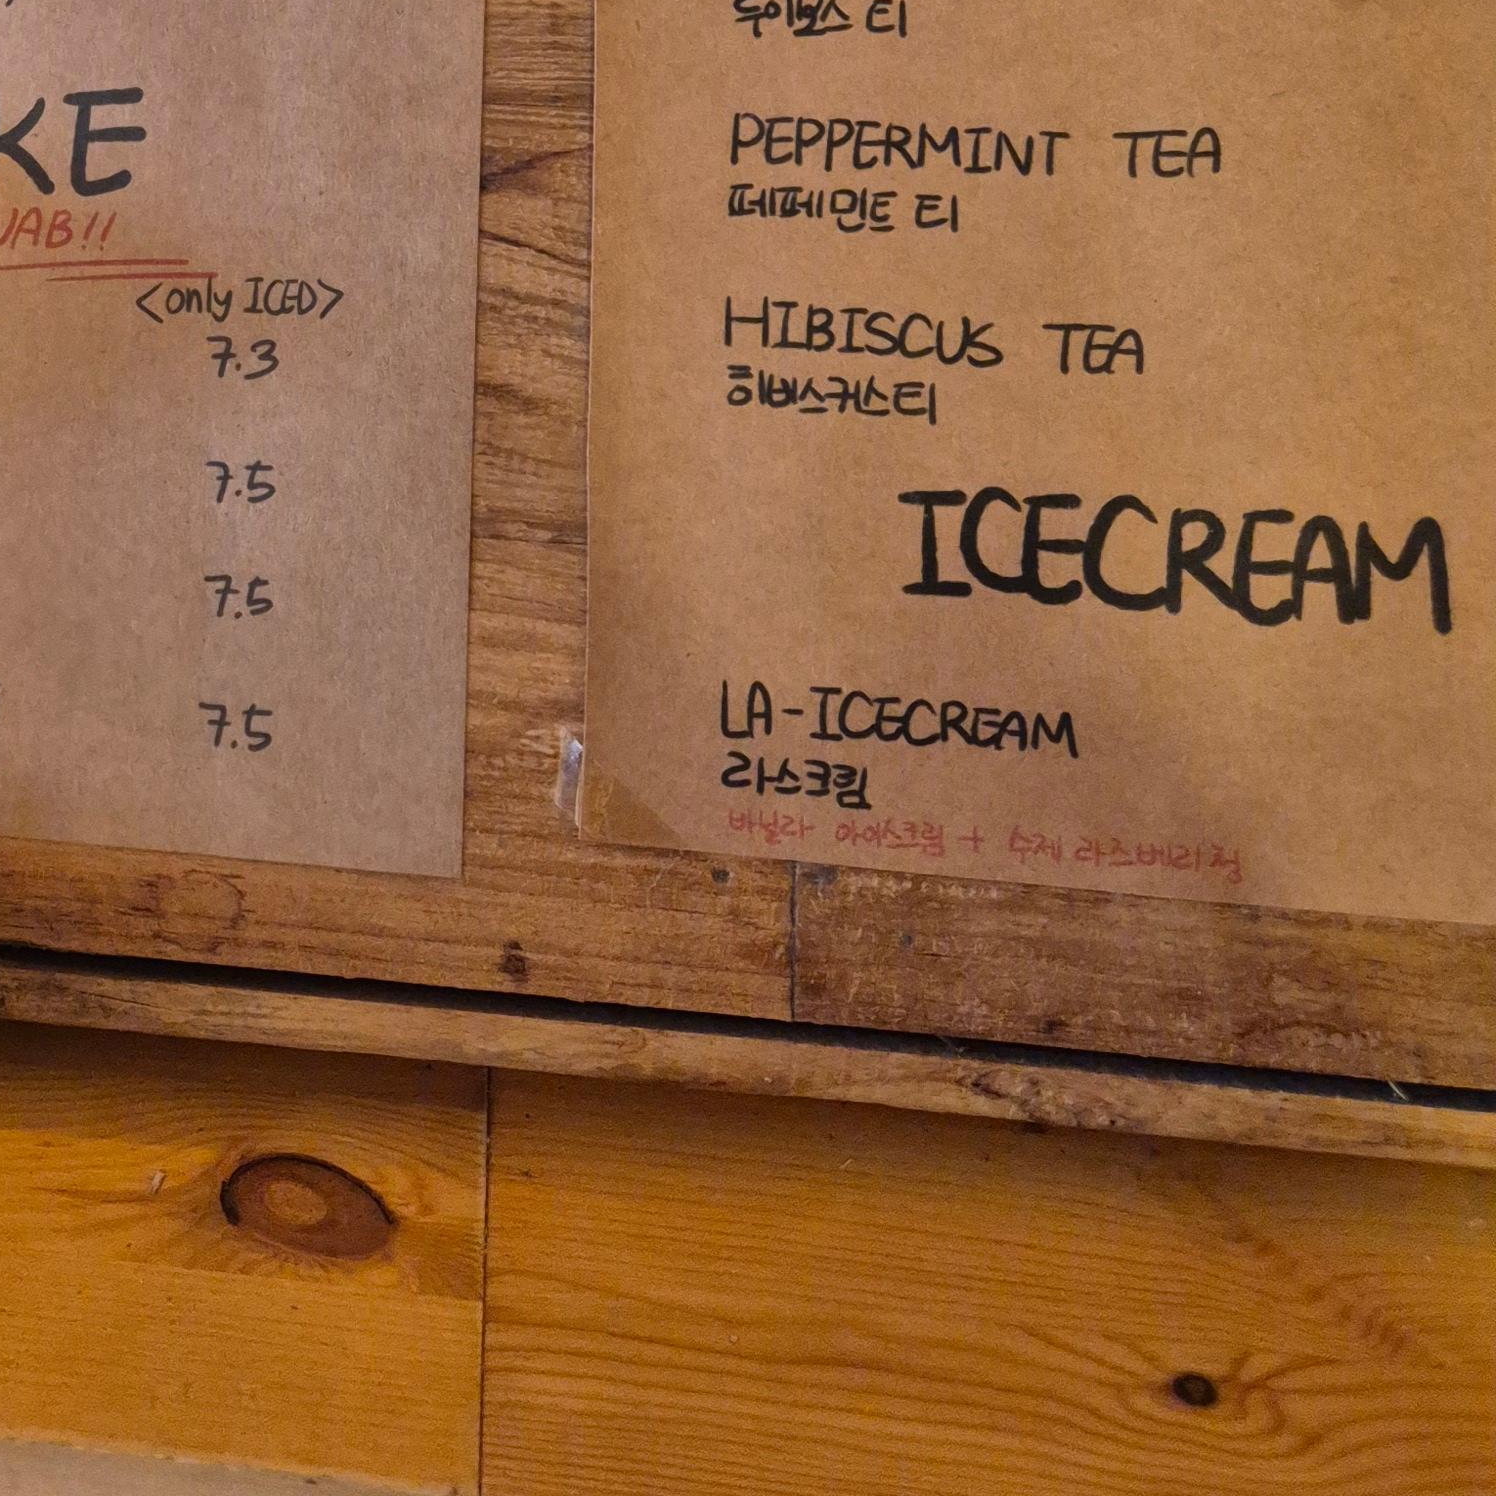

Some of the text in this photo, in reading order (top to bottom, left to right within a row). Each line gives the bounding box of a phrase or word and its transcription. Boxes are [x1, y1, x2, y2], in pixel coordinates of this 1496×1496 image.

[730, 112, 1223, 179] PEPPERMINT TEA
[914, 192, 960, 234] 티
[207, 335, 280, 380] 7.3
[724, 296, 1145, 376] HIBISCUS TEA
[726, 364, 937, 426] 히비스커스티
[207, 460, 277, 503] 7.5
[897, 486, 1454, 635] ICECREAM
[204, 574, 275, 621] 7.5
[199, 701, 273, 752] 7.5
[720, 679, 1080, 759] LA-ICECREAM
[720, 750, 872, 811] 라스크림
[728, 808, 816, 847] 바닐라
[835, 816, 946, 859] 아이스크림
[1008, 824, 1063, 866] 수제
